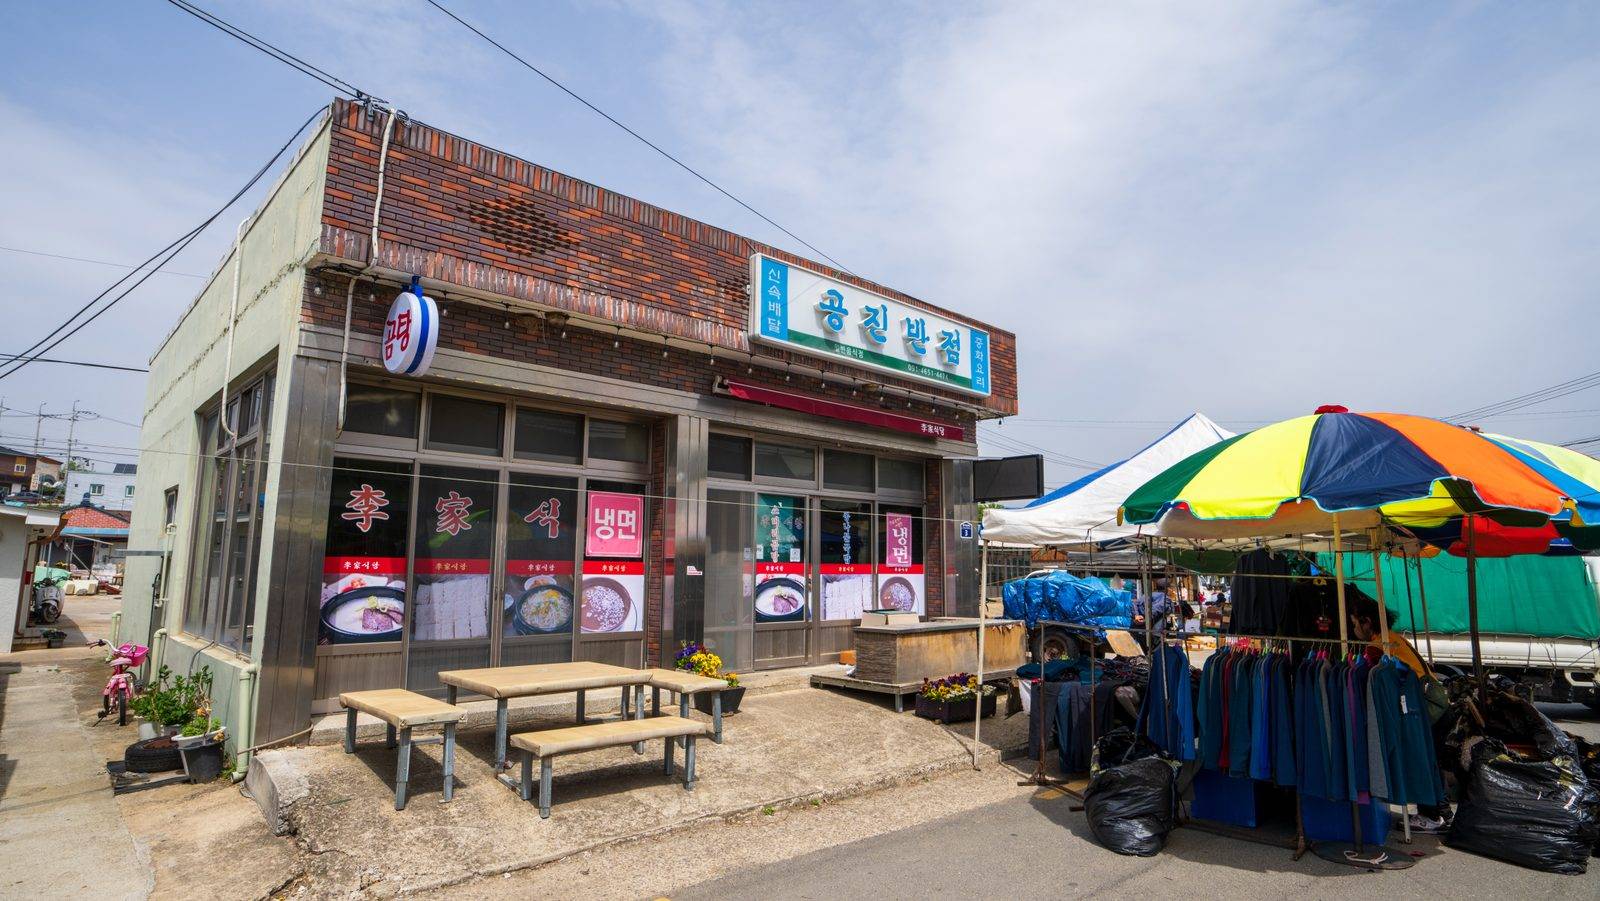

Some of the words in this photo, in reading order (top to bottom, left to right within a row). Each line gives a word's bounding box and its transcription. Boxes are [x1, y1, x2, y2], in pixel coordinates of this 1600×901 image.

[767, 267, 782, 334] 신속배달
[385, 309, 412, 361] 곰탕
[816, 288, 961, 367] 공진반점
[974, 336, 985, 388] 중화요리
[341, 484, 389, 532] 李
[435, 491, 473, 536] 家
[523, 498, 562, 538] 식
[594, 507, 637, 540] 냉면
[892, 526, 909, 563] 냉면
